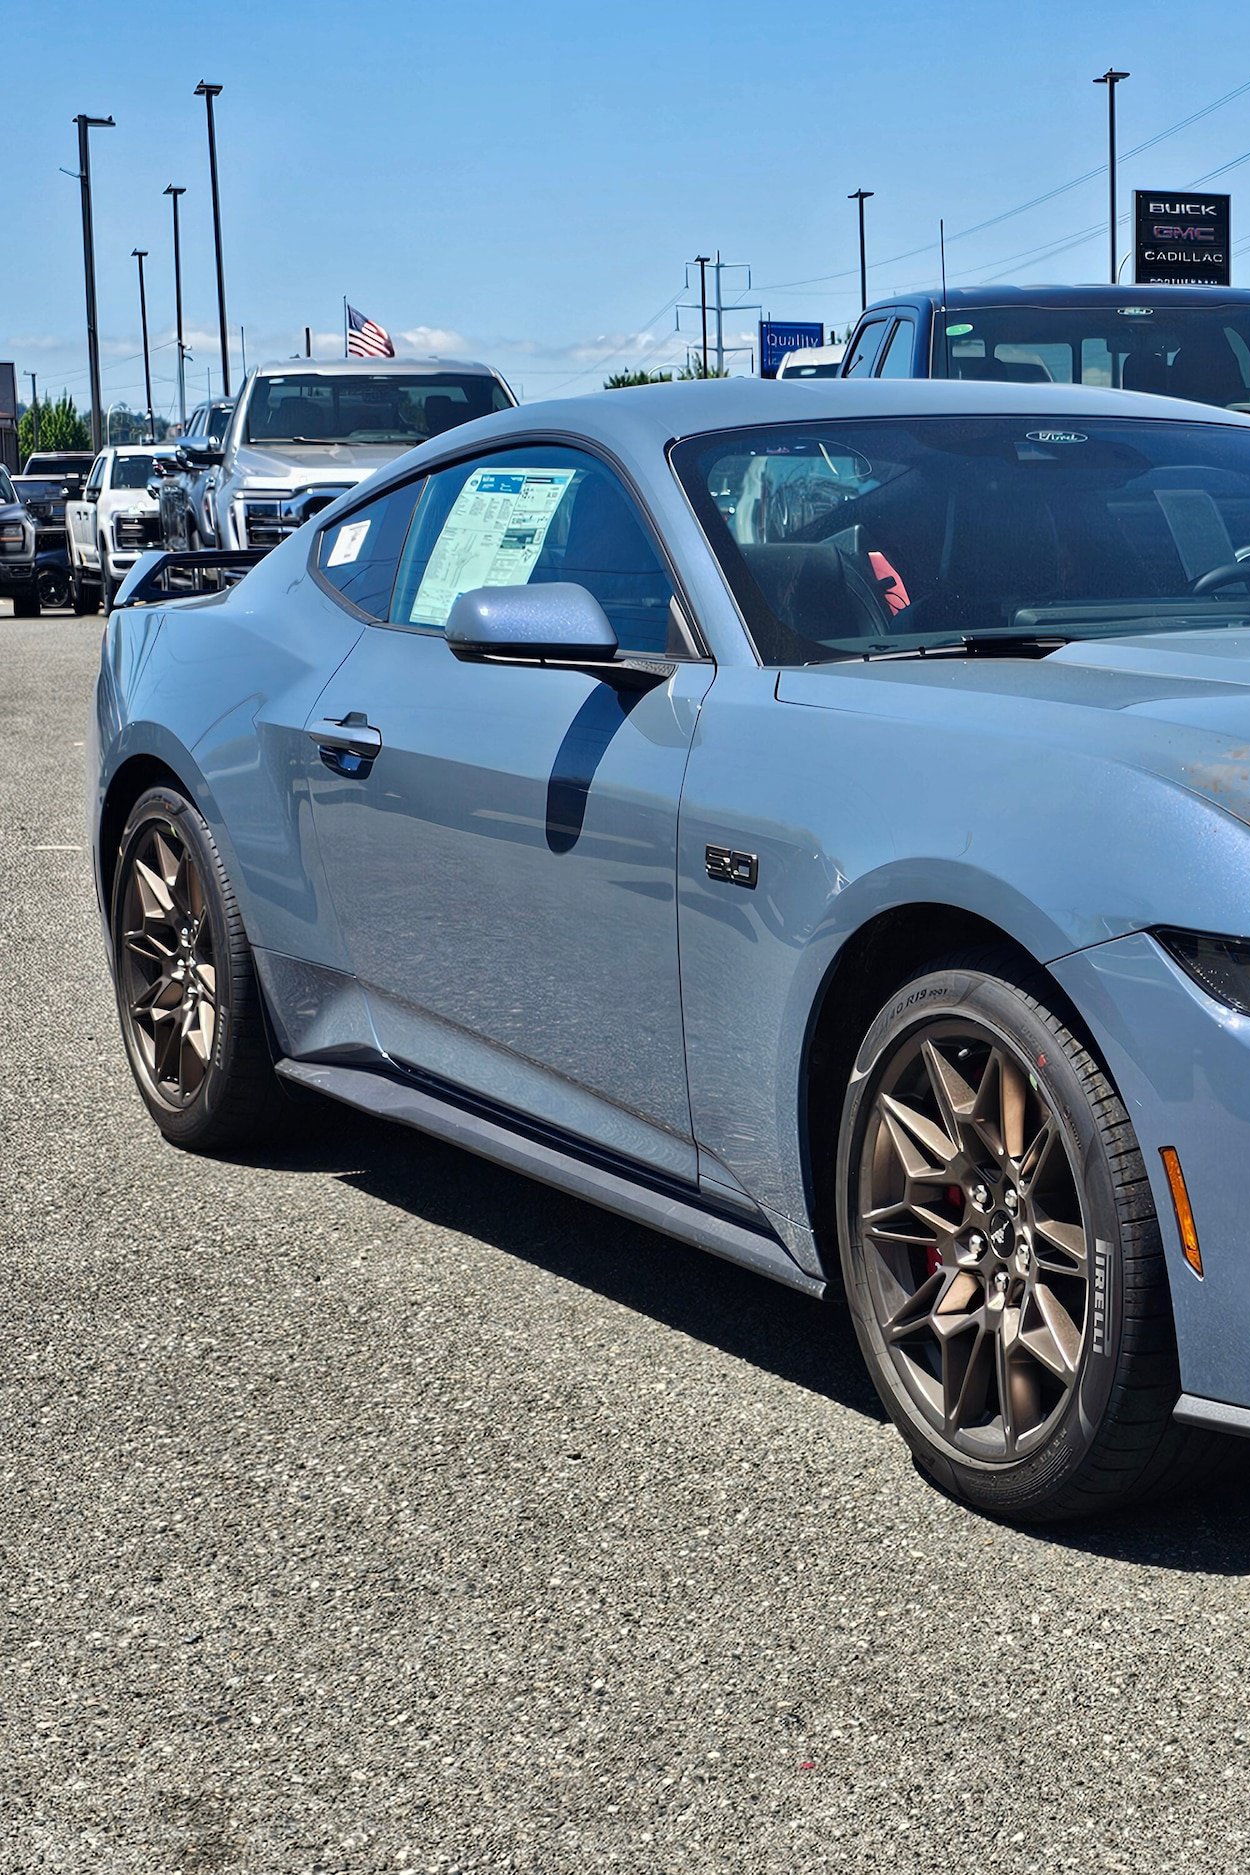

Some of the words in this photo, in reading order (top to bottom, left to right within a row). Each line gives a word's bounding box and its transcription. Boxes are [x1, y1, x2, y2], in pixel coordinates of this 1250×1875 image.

[1149, 203, 1217, 216] BUICK
[1153, 225, 1215, 240] GMC
[1144, 251, 1224, 263] CADILLAC
[766, 333, 819, 349] Quality
[705, 843, 758, 890] 5.0
[1093, 1238, 1115, 1357] PIRELLI
